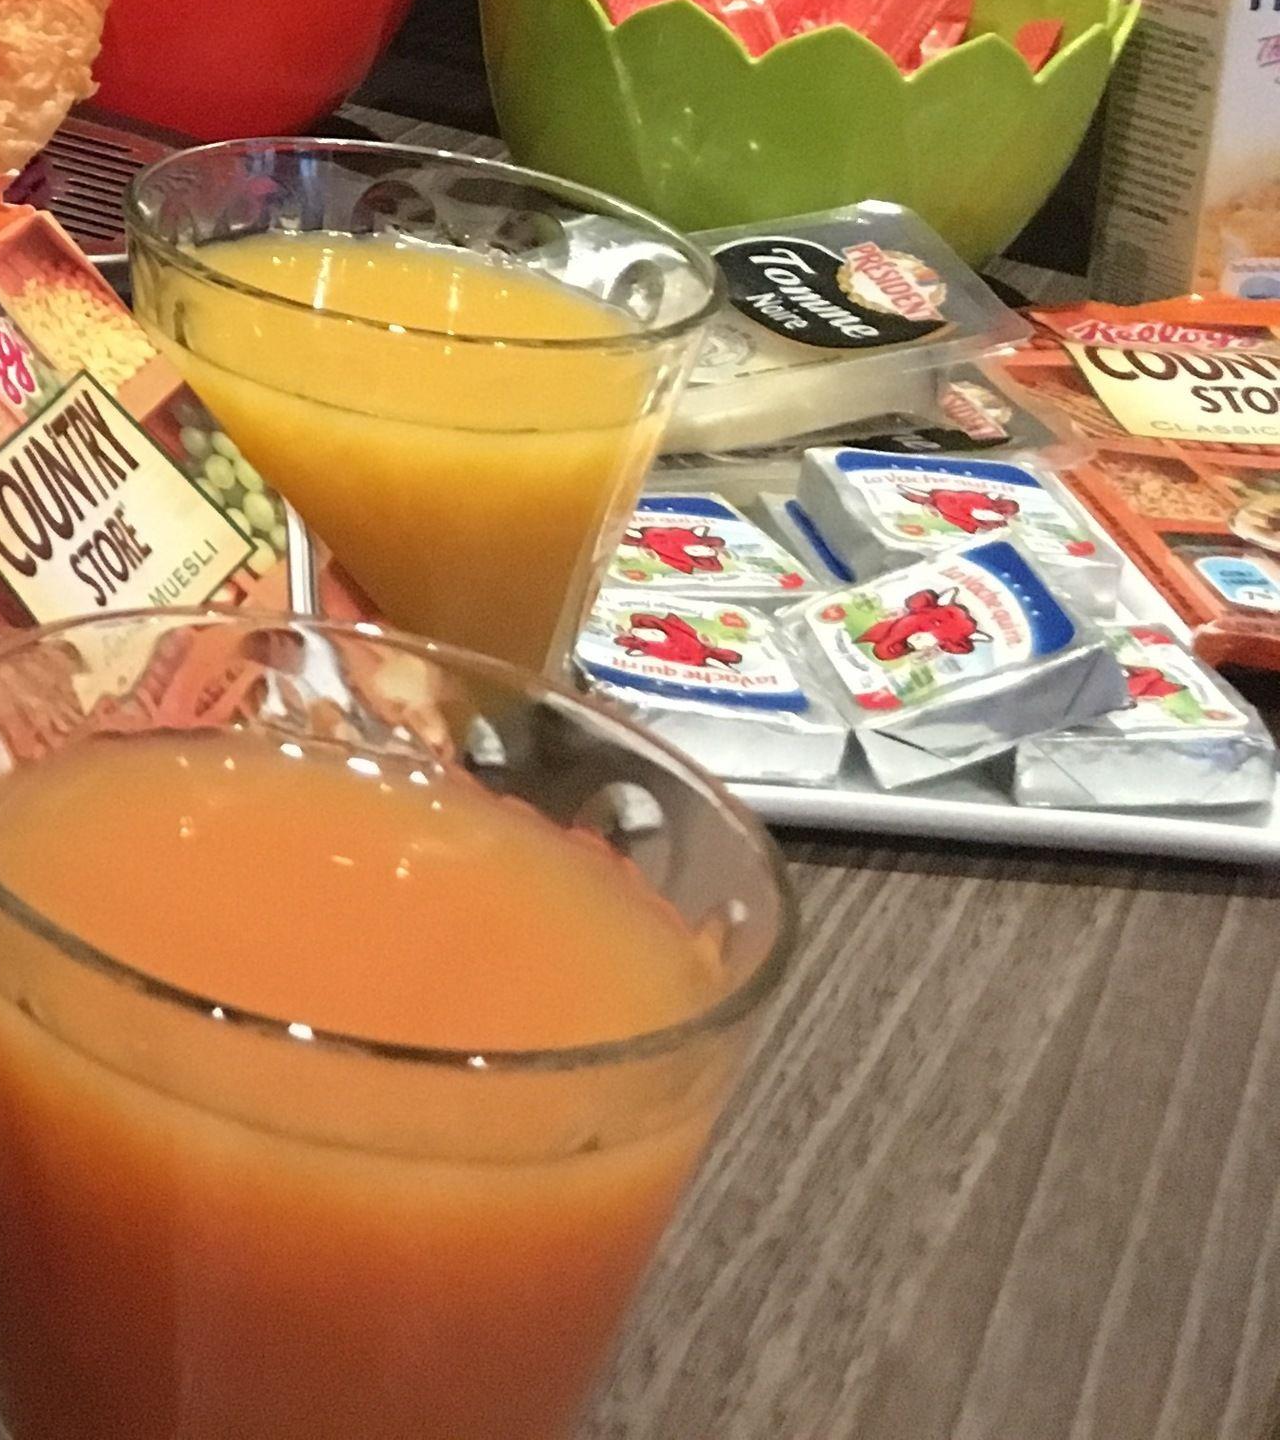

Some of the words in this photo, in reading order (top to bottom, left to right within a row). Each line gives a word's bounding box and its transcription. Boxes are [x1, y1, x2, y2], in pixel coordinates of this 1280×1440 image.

[745, 292, 809, 330] Noire
[748, 247, 880, 338] Tomme
[1191, 385, 1280, 415] STO
[69, 507, 153, 607] STORE
[147, 538, 220, 608] MUESLI
